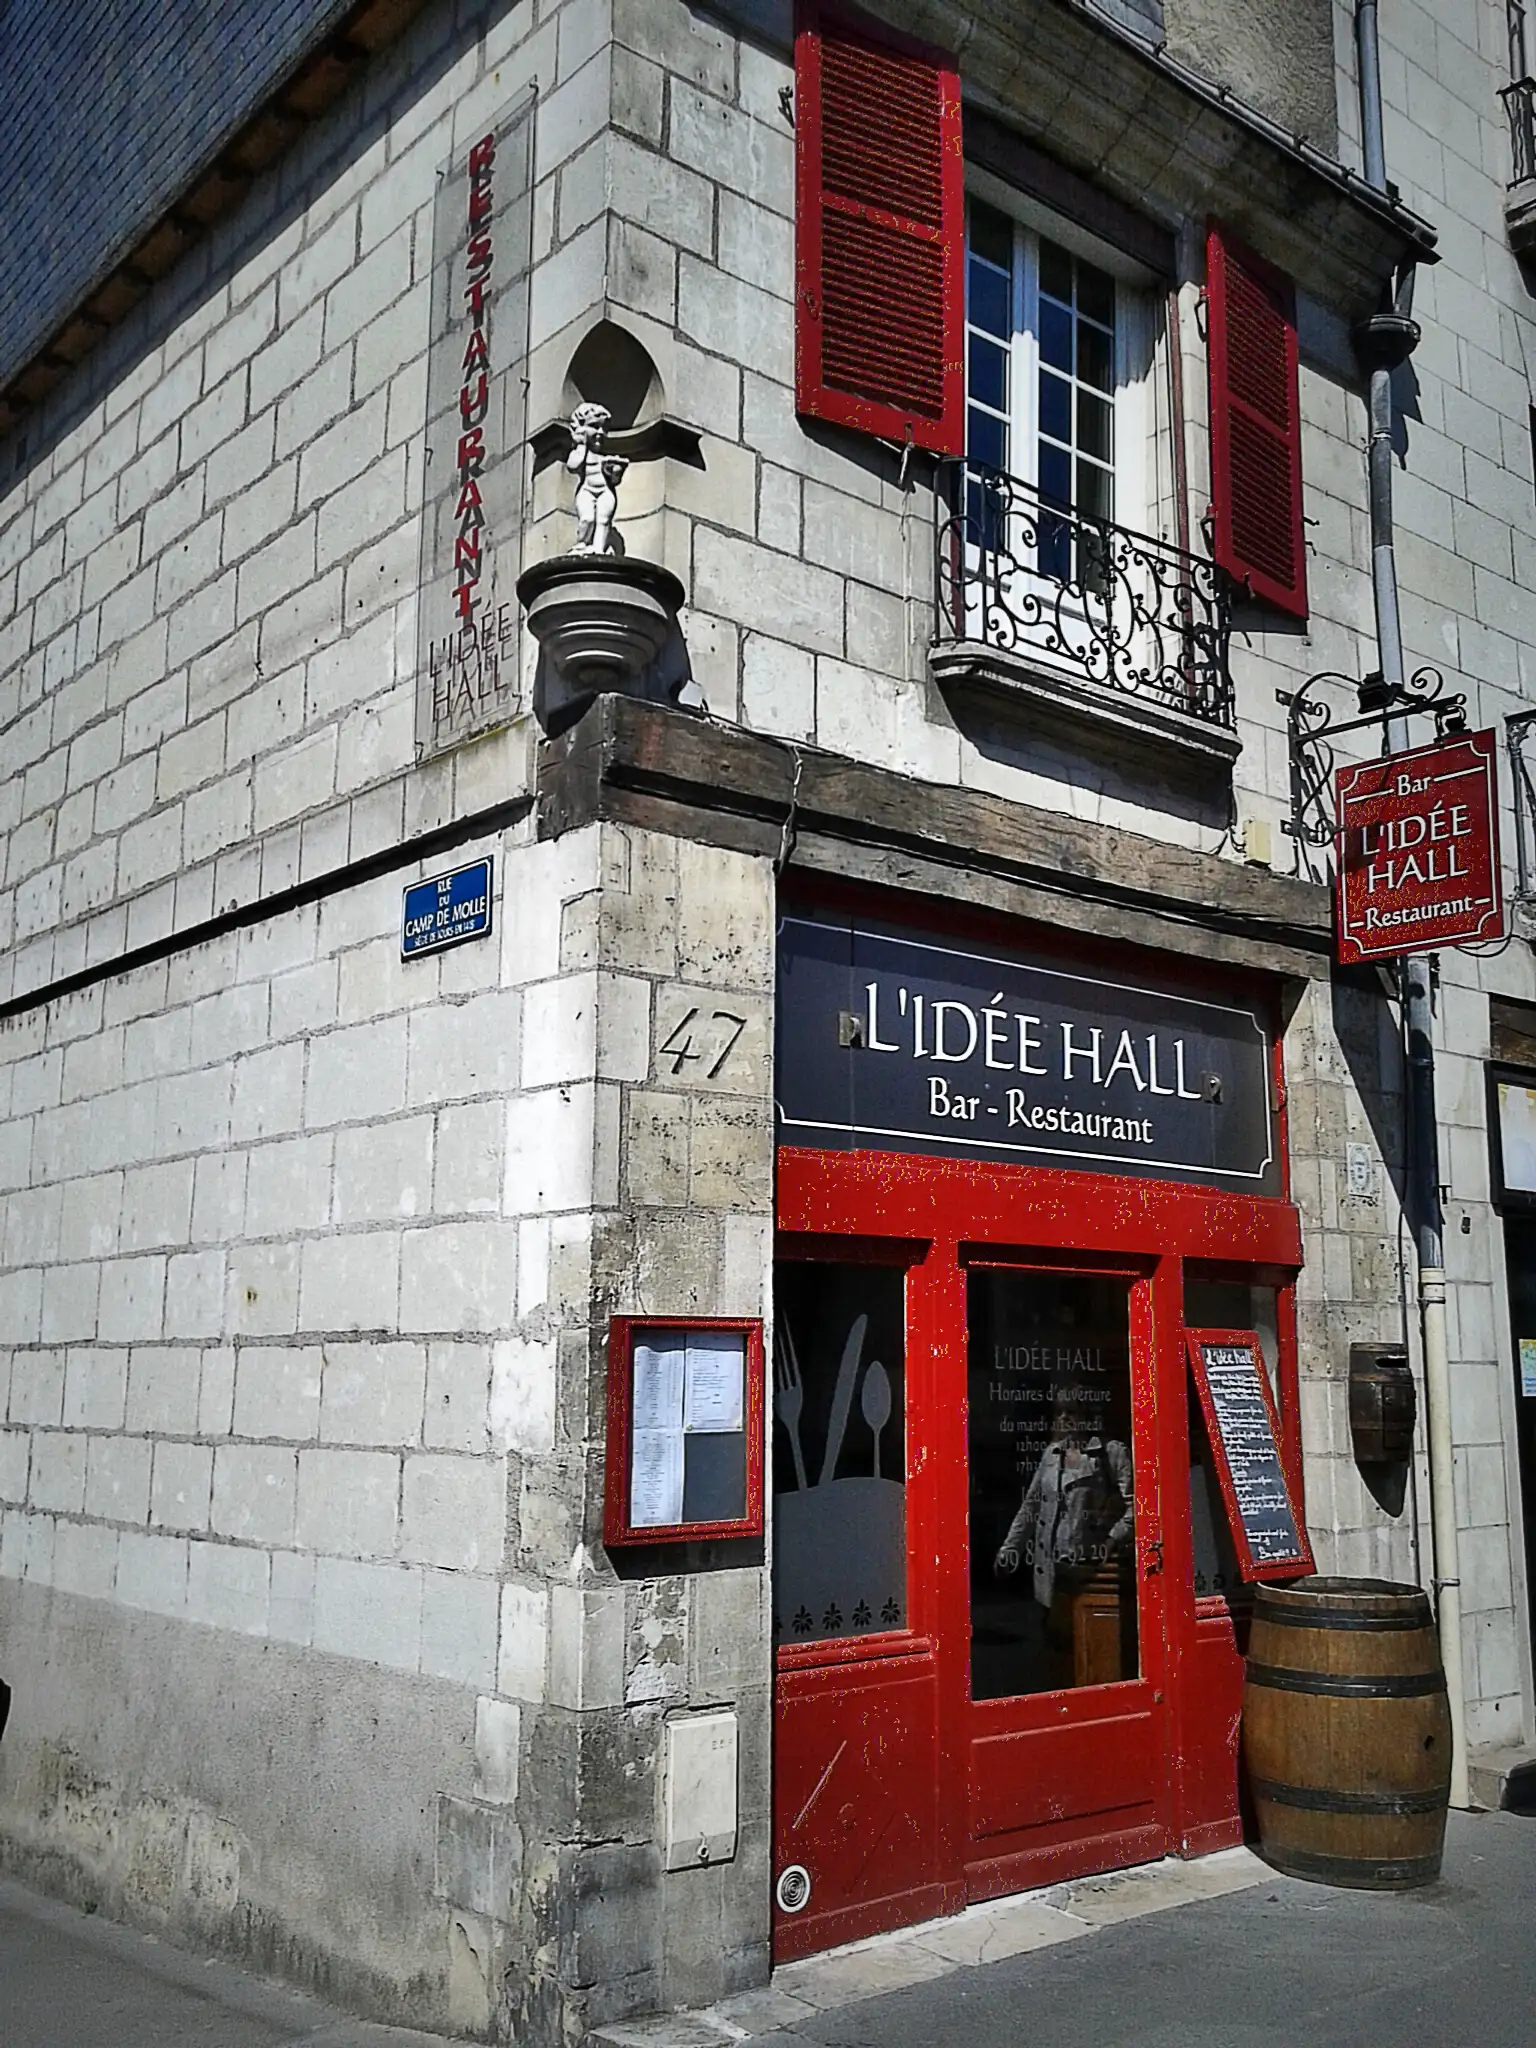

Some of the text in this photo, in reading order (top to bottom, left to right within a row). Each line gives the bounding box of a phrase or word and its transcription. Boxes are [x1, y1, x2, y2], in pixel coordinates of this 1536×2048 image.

[452, 133, 495, 617] RESTAURANT
[429, 600, 513, 679] L'IDÉE
[433, 653, 509, 723] HALL
[1397, 774, 1430, 797] Bar
[1361, 800, 1472, 856] L'IDÉE
[438, 878, 452, 893] RUE
[1366, 845, 1470, 894] HALL
[405, 914, 433, 937] CAMP
[437, 908, 450, 926] DE
[452, 896, 486, 922] MOLLE
[439, 895, 450, 907] DU
[1364, 896, 1473, 931] Restaurant
[659, 1007, 748, 1080] 47
[865, 982, 1203, 1100] L'IDÉE HALL
[927, 1076, 981, 1121] Bar
[1006, 1088, 1154, 1145] Restaurant
[994, 1340, 1107, 1371] L'IDÉE HALL
[989, 1381, 1044, 1402] Horaires
[1016, 1416, 1048, 1432] mardi
